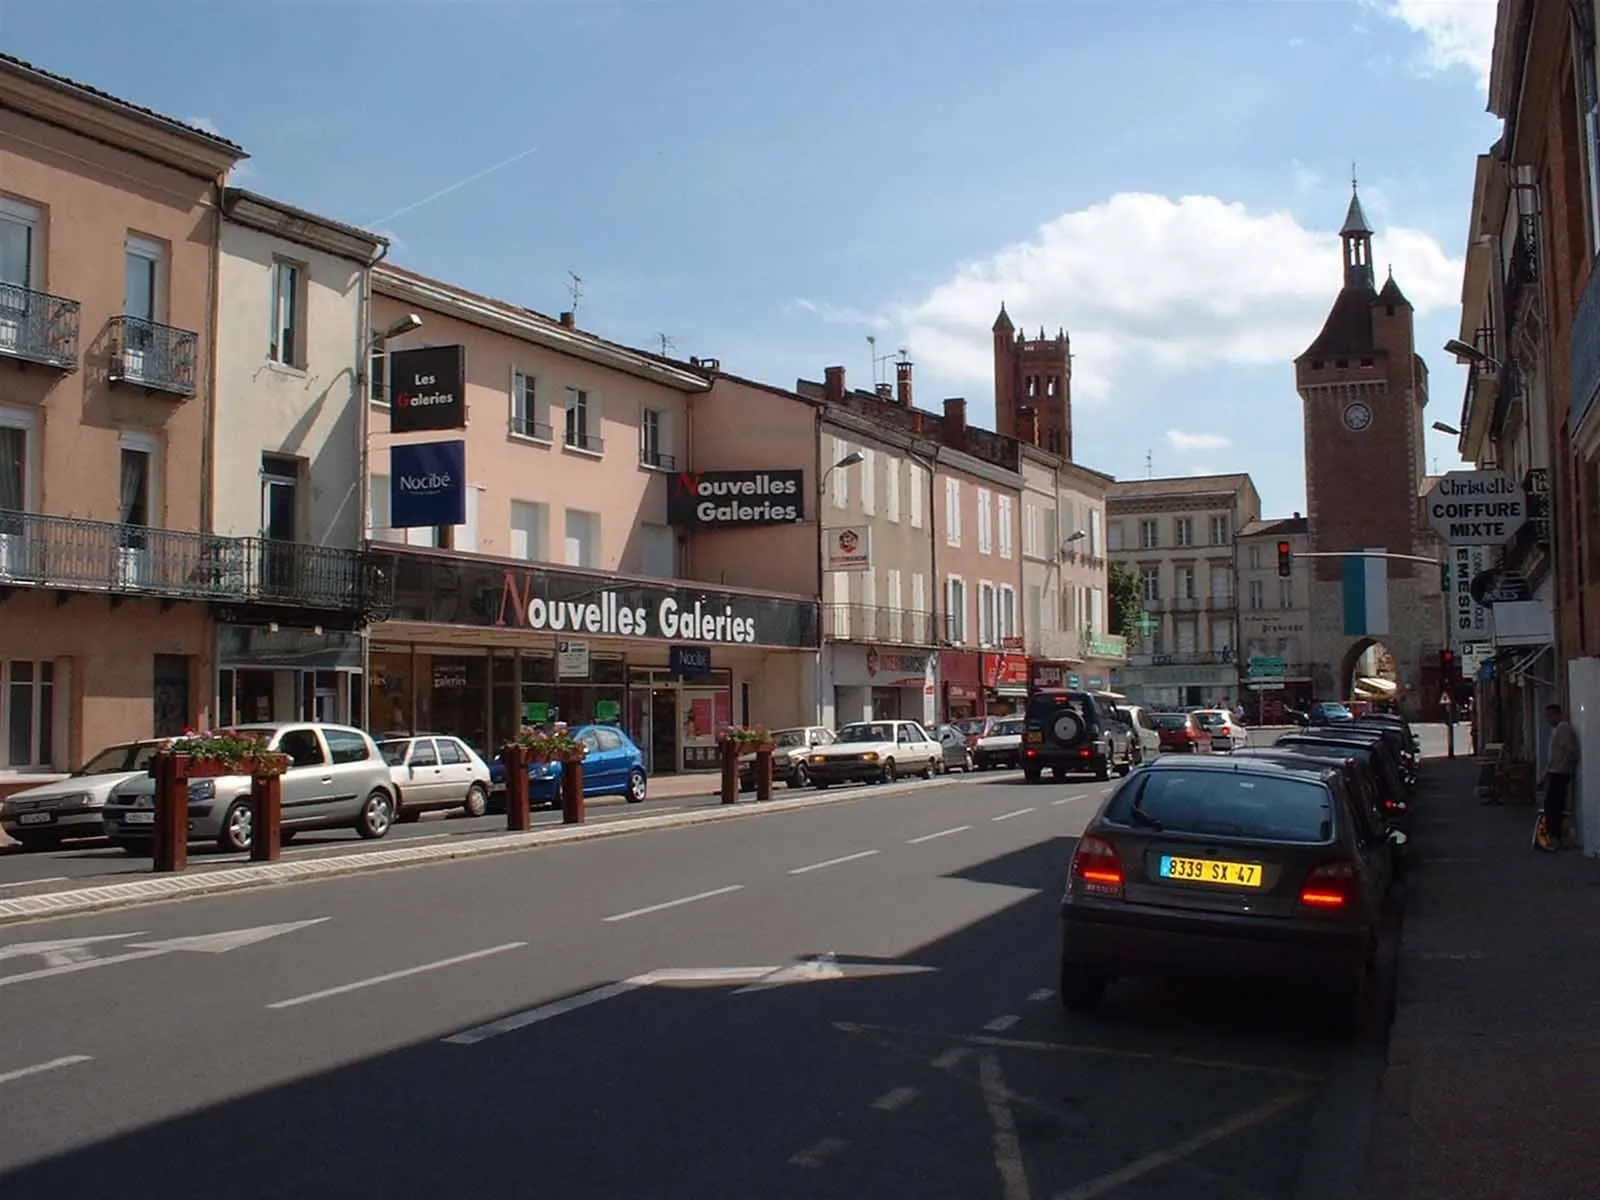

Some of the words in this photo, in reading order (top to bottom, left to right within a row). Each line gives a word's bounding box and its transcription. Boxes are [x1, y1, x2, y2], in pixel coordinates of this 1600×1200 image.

[415, 374, 436, 386] Les
[396, 391, 454, 407] Galeries
[400, 472, 451, 491] Nocibé
[675, 471, 797, 497] Nouvelles
[1439, 477, 1515, 497] Christelle
[696, 500, 797, 522] Galeries
[1432, 502, 1521, 519] COIFFURE
[1449, 522, 1505, 537] MIXTE
[1457, 548, 1471, 630] EMESIS
[495, 569, 648, 636] Nouvelles
[658, 597, 756, 643] Galeries
[1169, 860, 1203, 878] 8339
[1212, 863, 1229, 881] SX
[1237, 865, 1255, 883] 47
